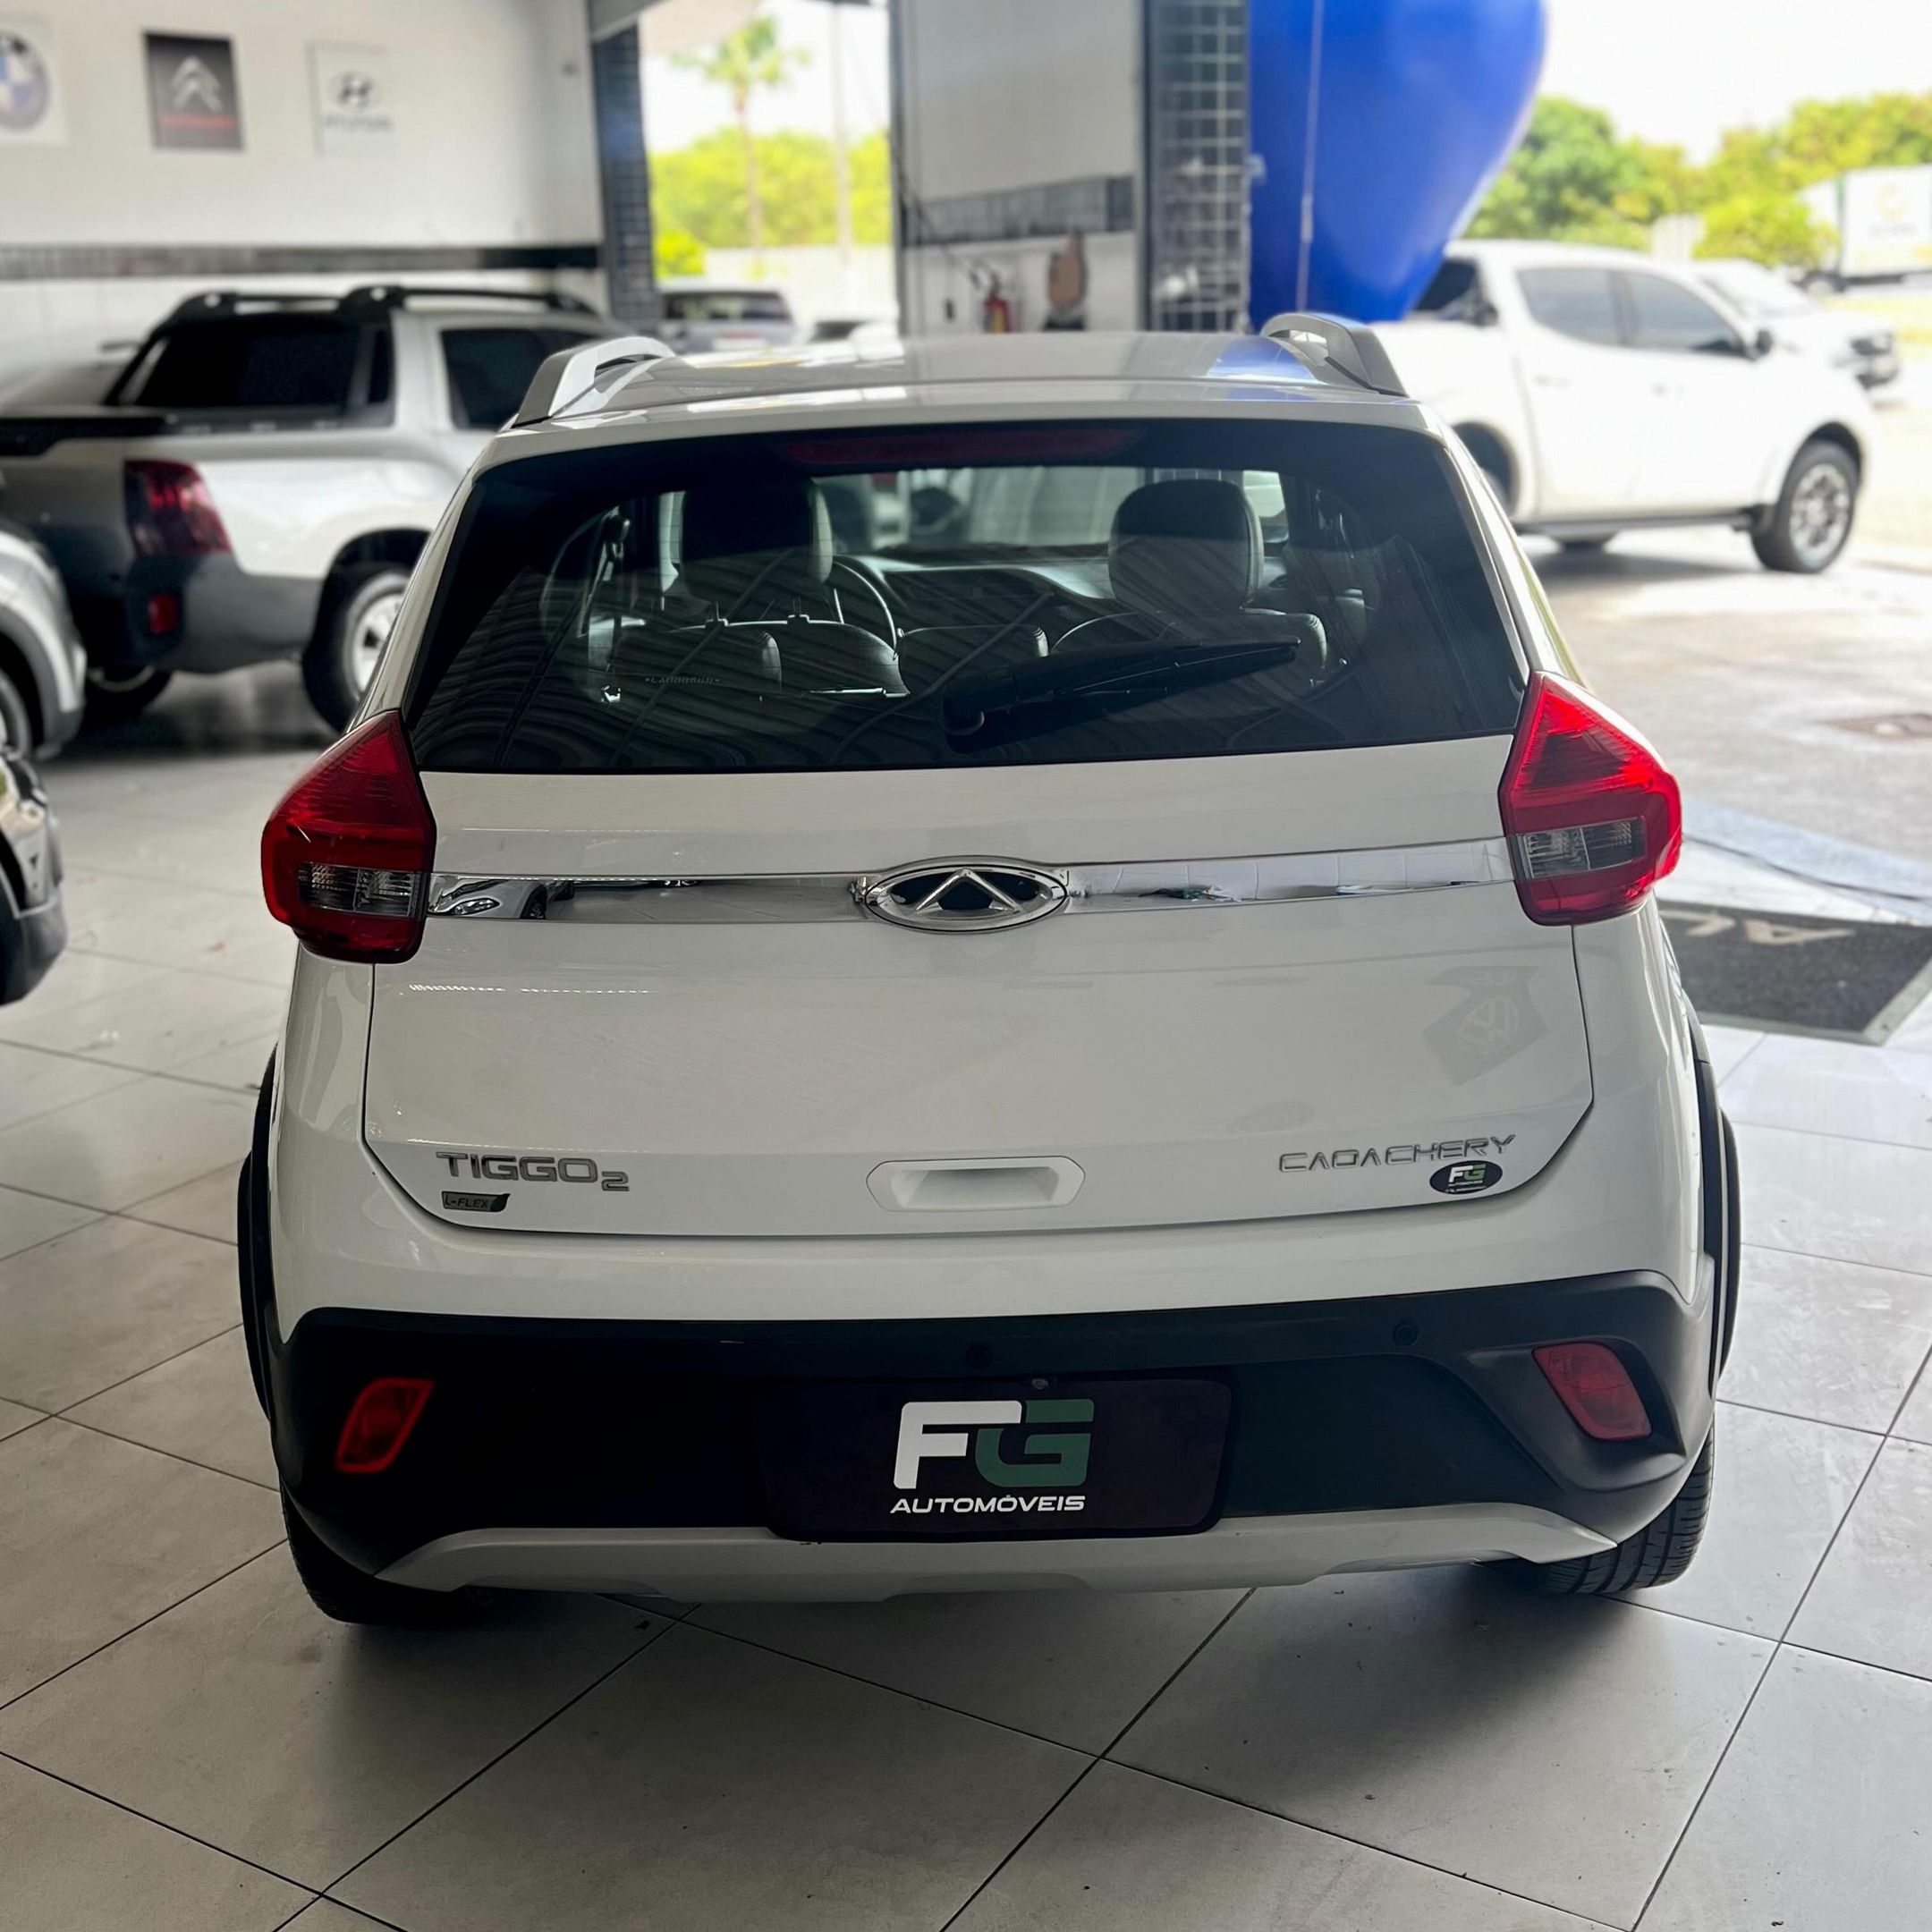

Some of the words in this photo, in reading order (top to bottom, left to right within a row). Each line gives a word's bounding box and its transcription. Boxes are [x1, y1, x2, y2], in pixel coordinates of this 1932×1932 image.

[1449, 1165, 1487, 1182] FG
[894, 1399, 1094, 1489] FG
[890, 1495, 1085, 1513] AUTOMÓVEIS
